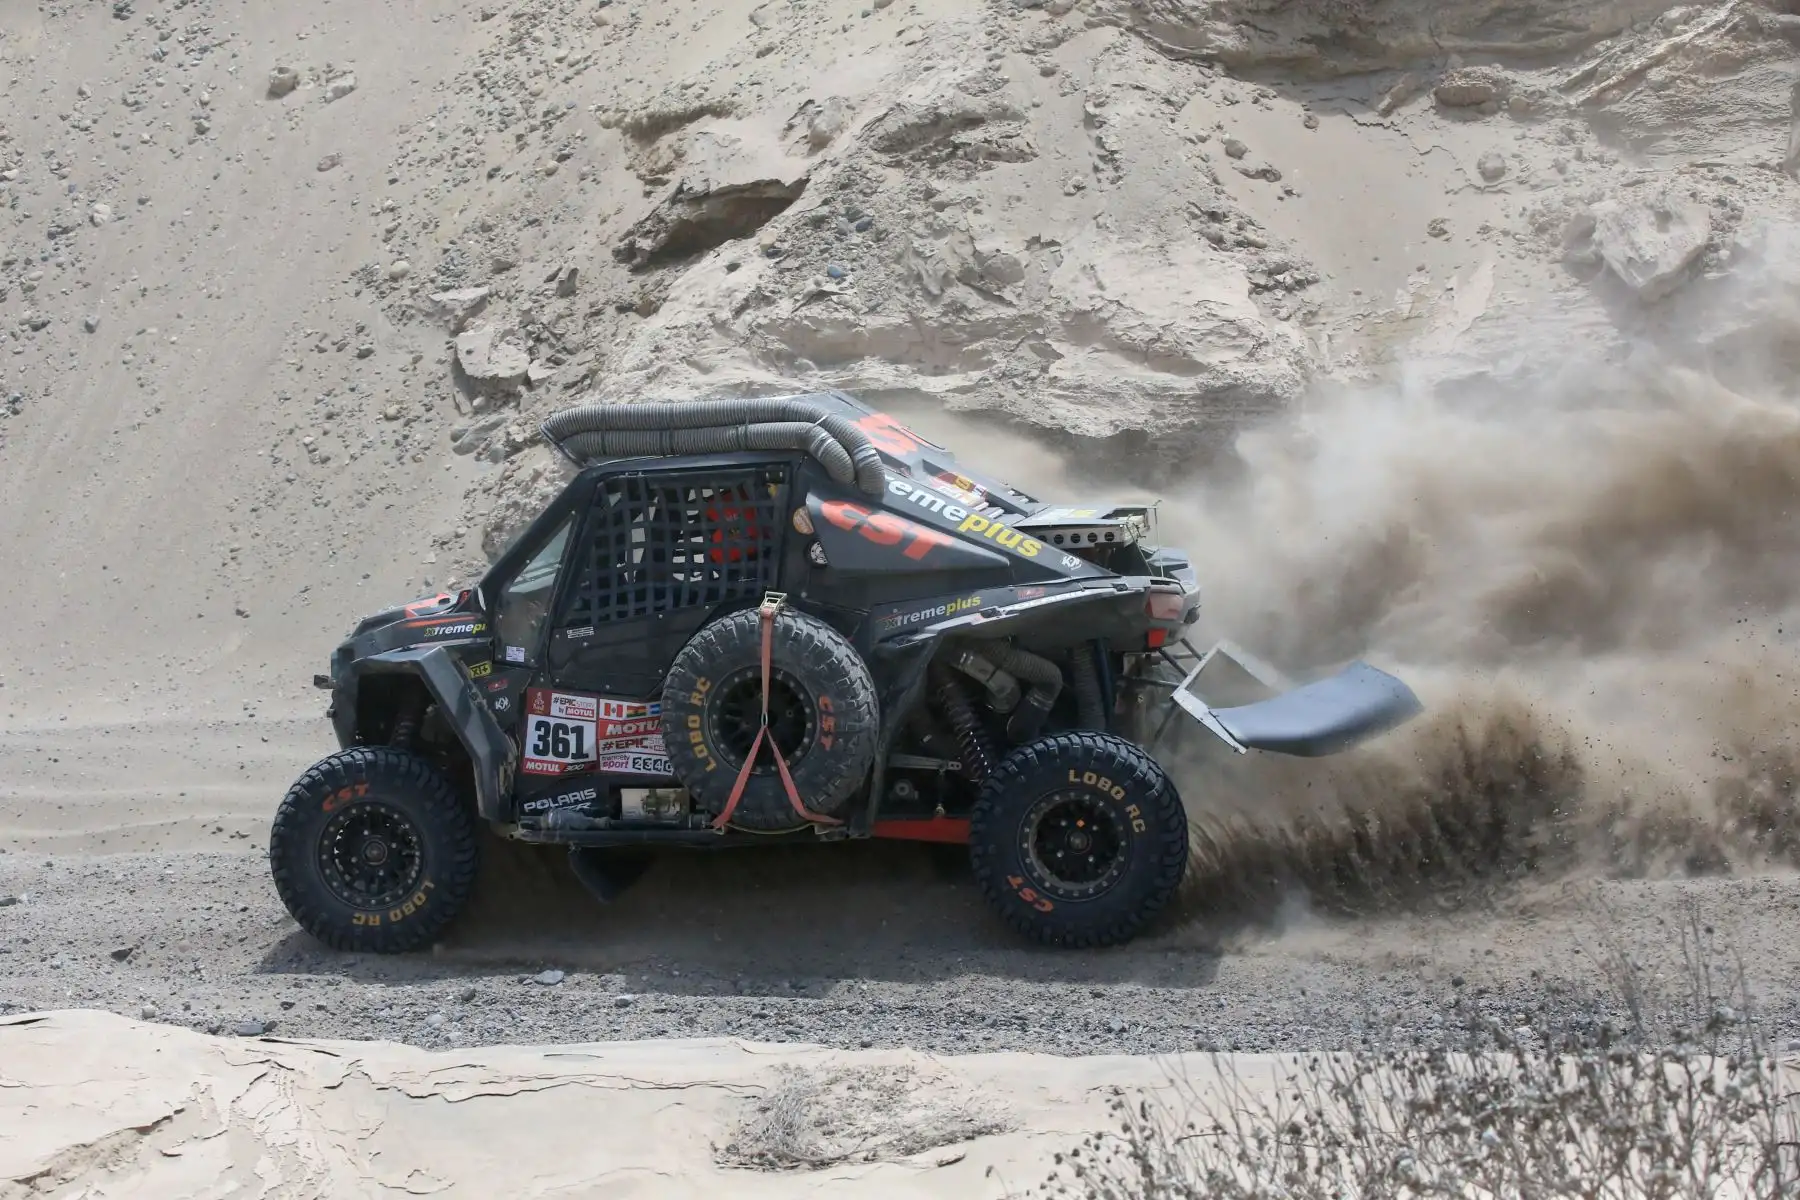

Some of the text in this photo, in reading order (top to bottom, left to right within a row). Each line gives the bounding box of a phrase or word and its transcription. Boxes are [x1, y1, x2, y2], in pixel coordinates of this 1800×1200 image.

[820, 499, 954, 561] CST
[691, 677, 711, 706] RC
[567, 708, 593, 717] MOTUL
[606, 719, 661, 735] MOTU
[532, 720, 589, 760] 361
[687, 714, 717, 772] LOBO
[525, 760, 560, 772] MOTUL
[602, 760, 629, 769] sport
[322, 782, 369, 812] CST
[524, 788, 597, 812] POLARIS
[1068, 769, 1146, 833] LOBO RC
[352, 881, 435, 926] LOBO RC
[1007, 875, 1054, 913] CST
